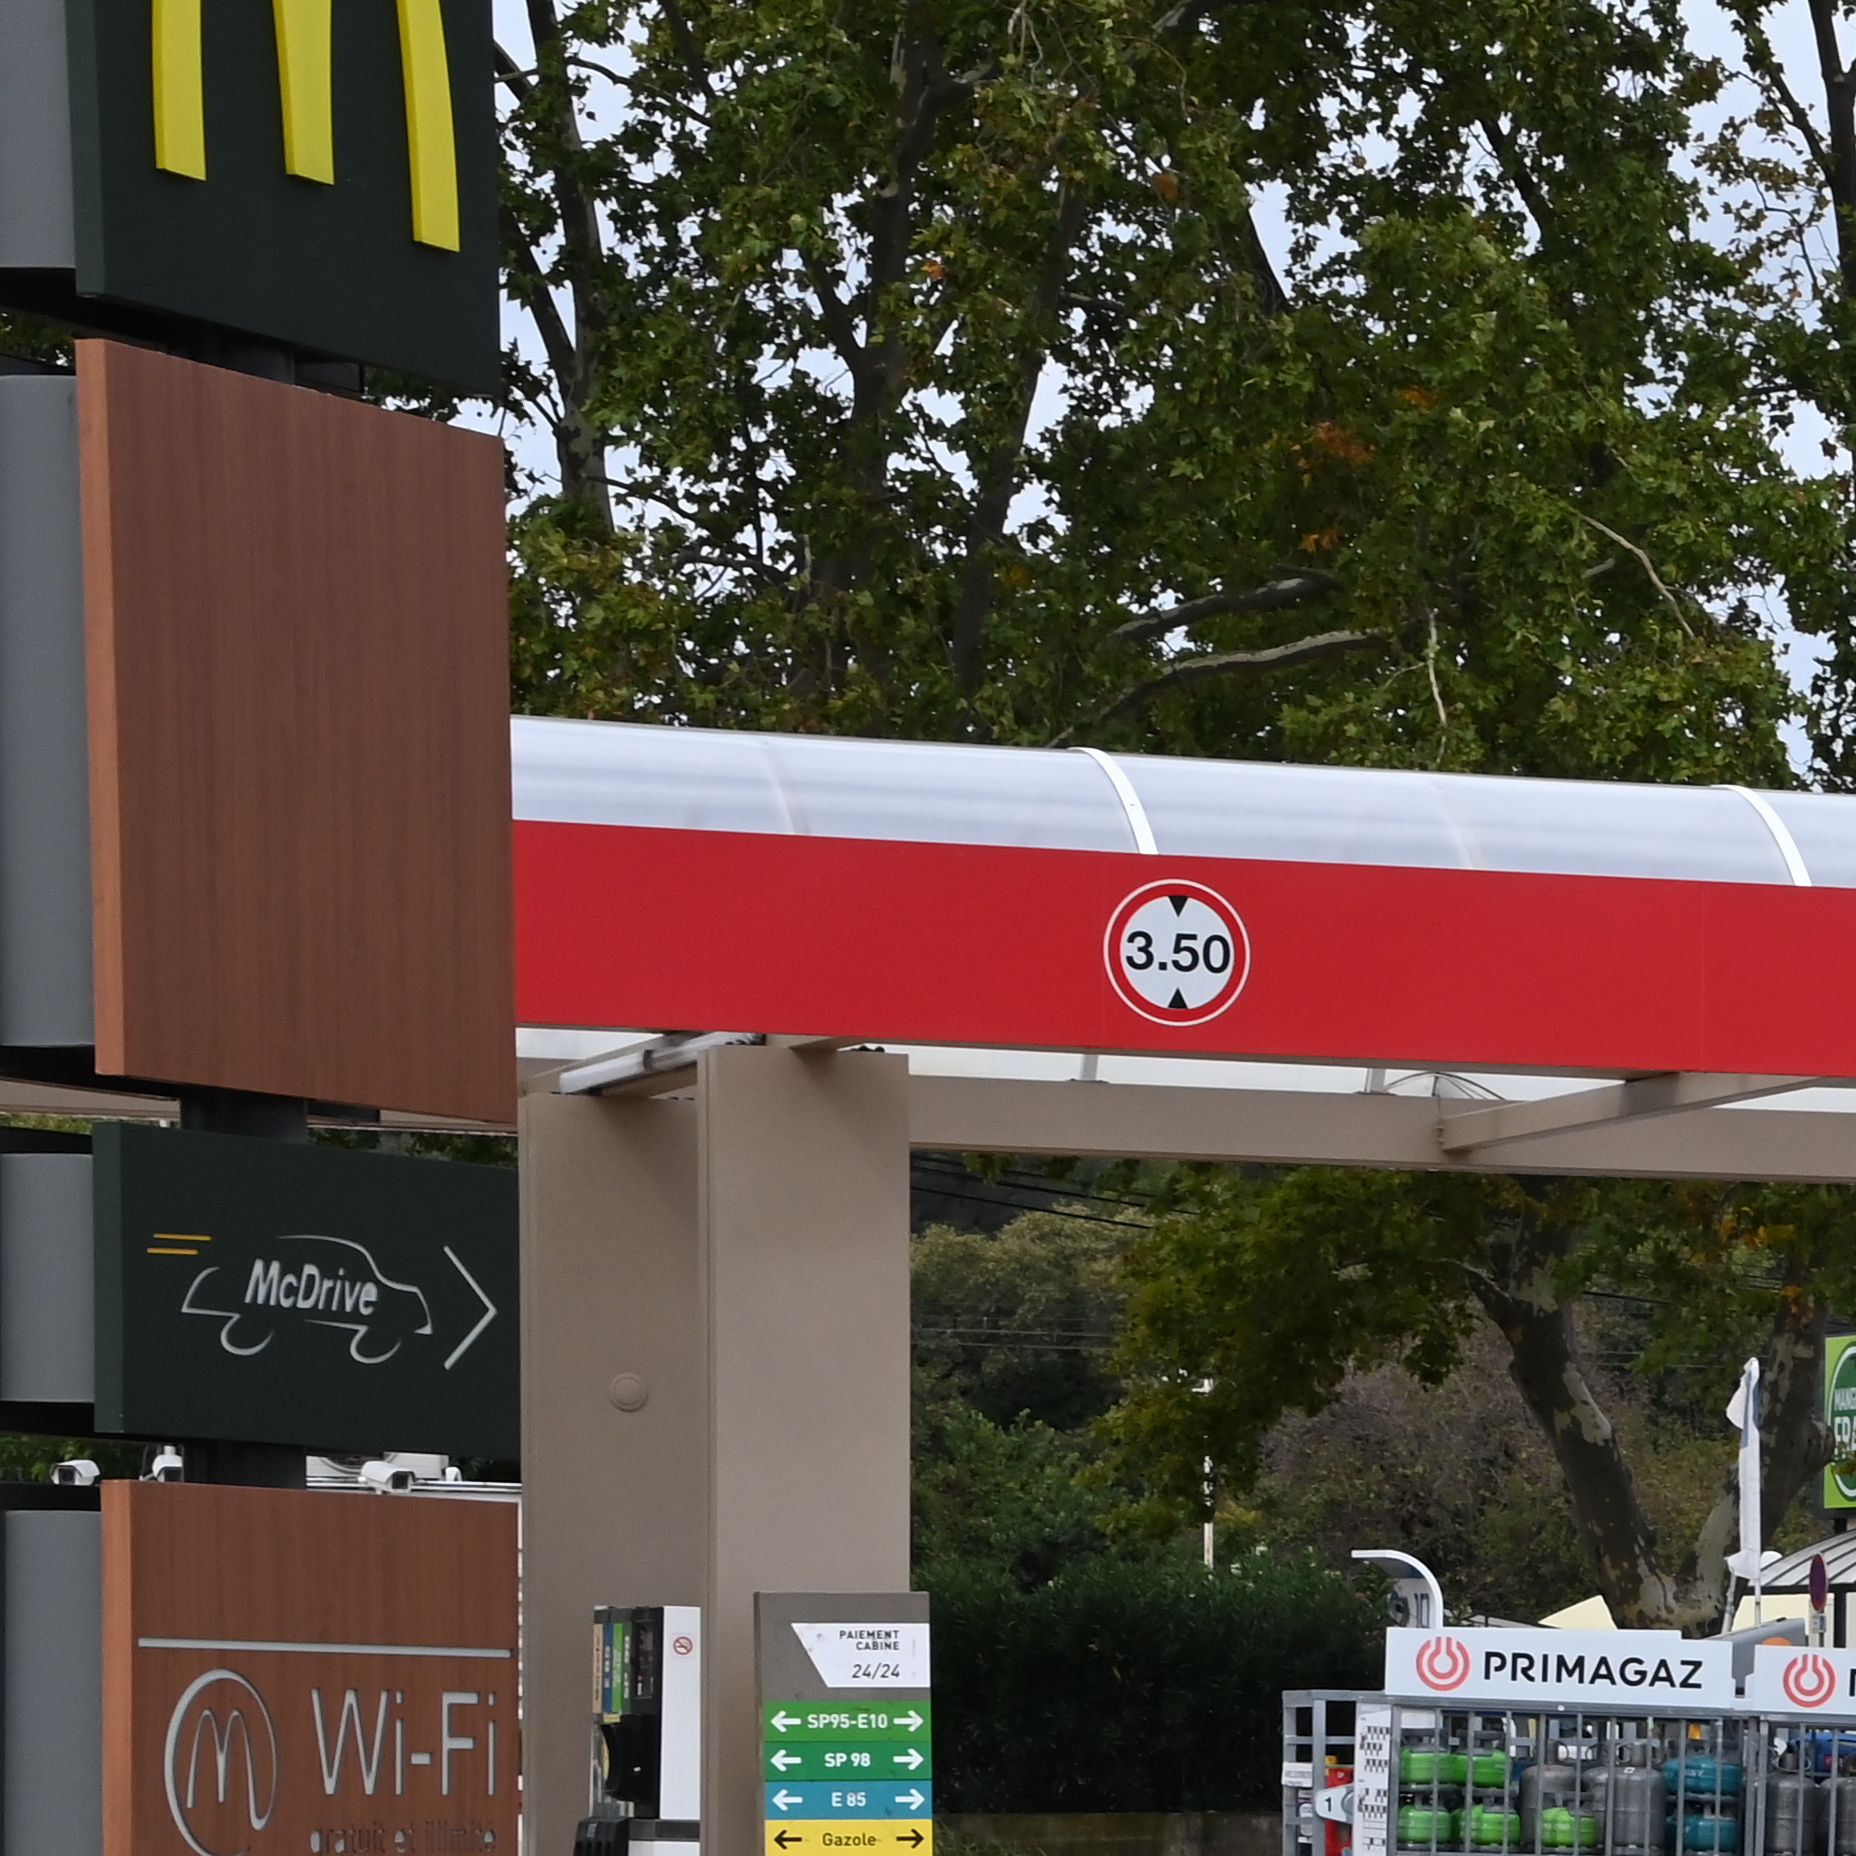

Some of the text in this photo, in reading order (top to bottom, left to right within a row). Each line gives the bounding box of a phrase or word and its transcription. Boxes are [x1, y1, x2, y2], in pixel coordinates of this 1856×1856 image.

[1125, 930, 1231, 974] 3.50
[245, 1258, 378, 1316] McDrive
[839, 1630, 900, 1640] PAIEMENT
[856, 1641, 900, 1651] CABINE
[852, 1663, 900, 1679] 24/24
[1483, 1651, 1704, 1689] PRIMAGAZ
[807, 1713, 888, 1729] SP95-E10
[311, 1688, 497, 1796] Wi-Fi
[824, 1752, 871, 1767] SP 98
[831, 1792, 867, 1807] E 85
[1324, 1797, 1332, 1812] 1
[822, 1832, 877, 1846] Gazole
